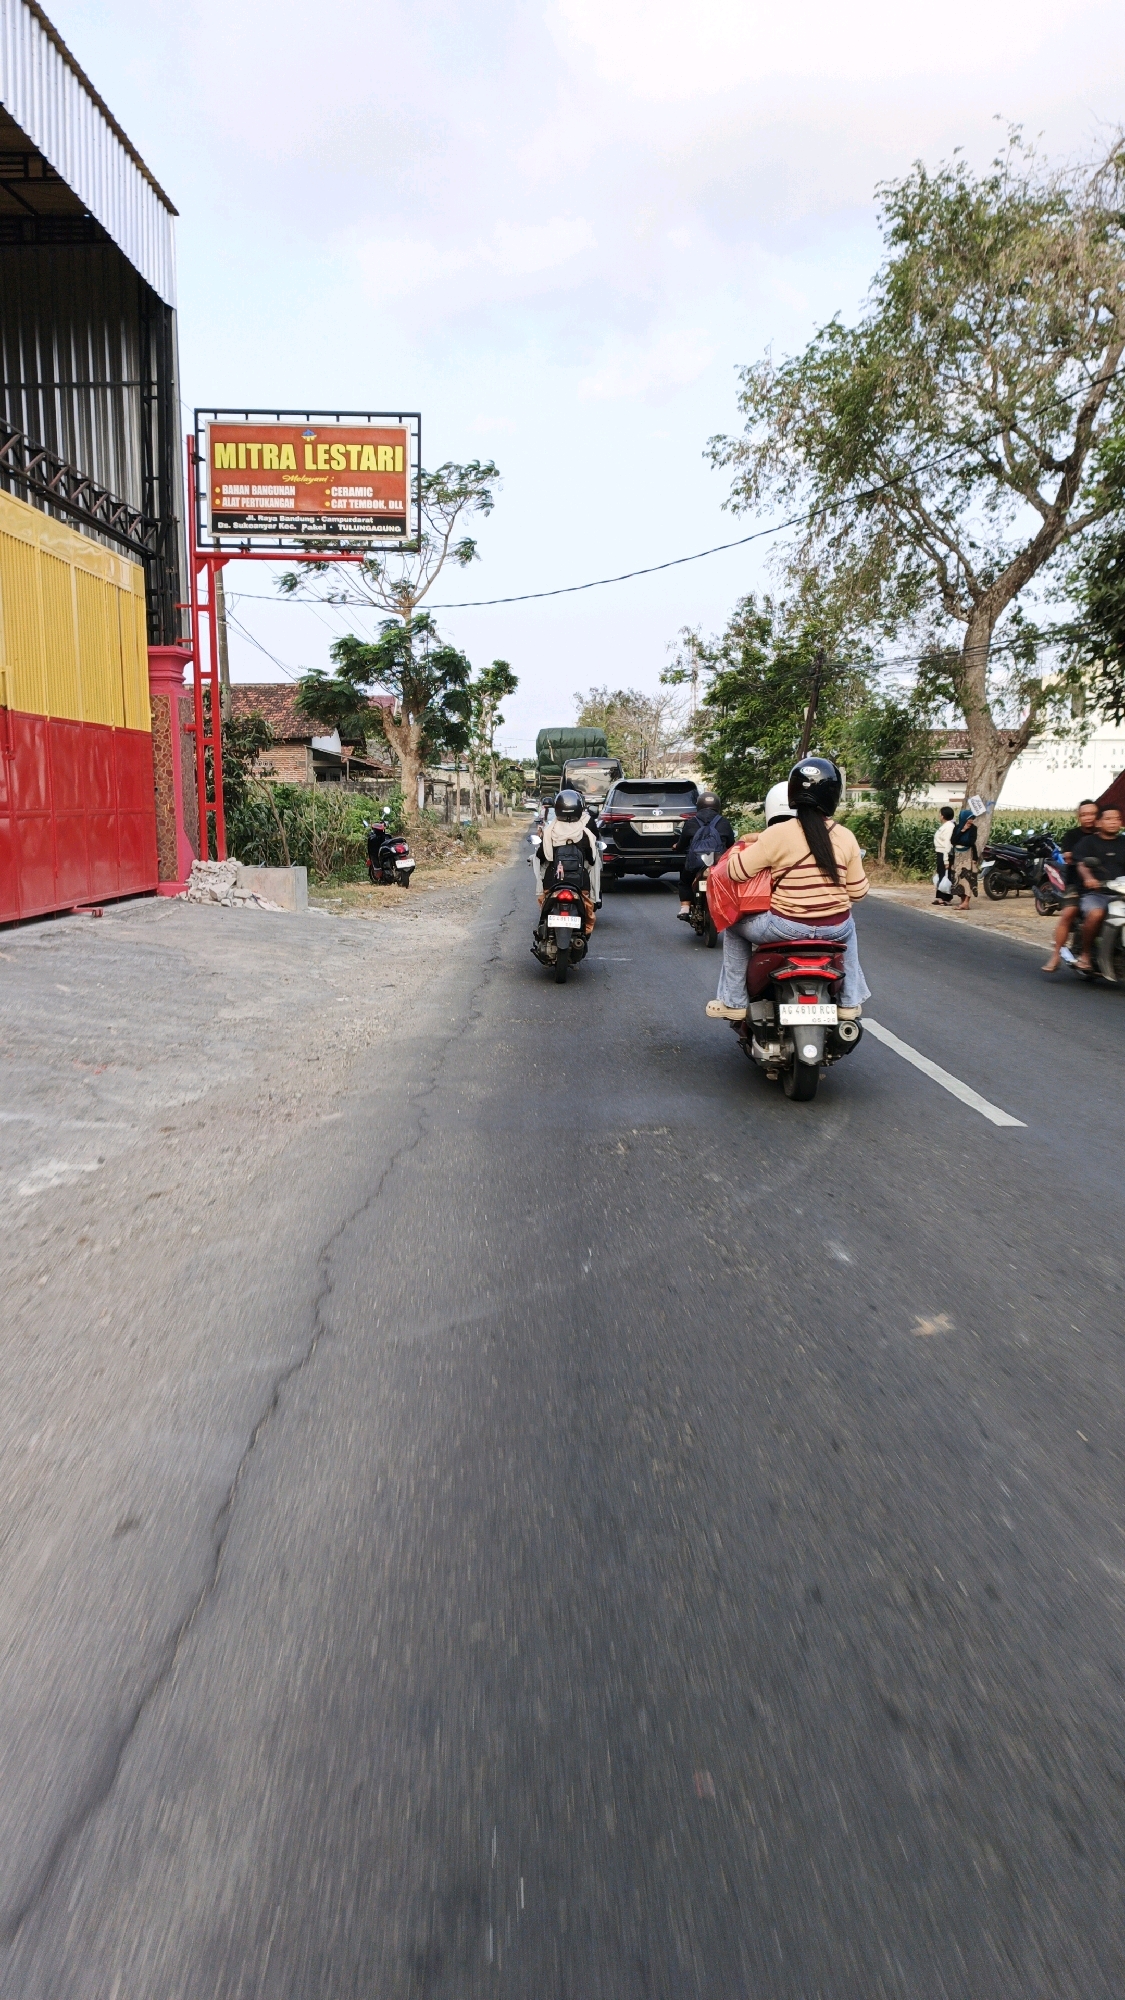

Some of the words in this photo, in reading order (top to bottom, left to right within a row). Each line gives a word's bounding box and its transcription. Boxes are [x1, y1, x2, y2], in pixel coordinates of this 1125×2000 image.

[214, 442, 297, 470] MITRA
[304, 443, 404, 472] LESTARI
[222, 484, 250, 495] BAHAN
[251, 485, 296, 496] BANGUNAN
[331, 486, 374, 497] CERAMIC
[222, 496, 240, 508] ALAT
[241, 497, 295, 509] PERTUKANGAN
[331, 498, 347, 509] CAT
[349, 499, 387, 510] TEMBOK,
[388, 500, 404, 510] DLL
[257, 515, 278, 523] Raya
[279, 515, 315, 524] Bandung
[321, 516, 374, 524] Campurdarat
[278, 522, 297, 530] Kec.
[301, 523, 327, 533] Pakel
[338, 523, 402, 532] TULUNGAGUNG
[782, 1005, 793, 1015] AG
[795, 1005, 817, 1015] 4610
